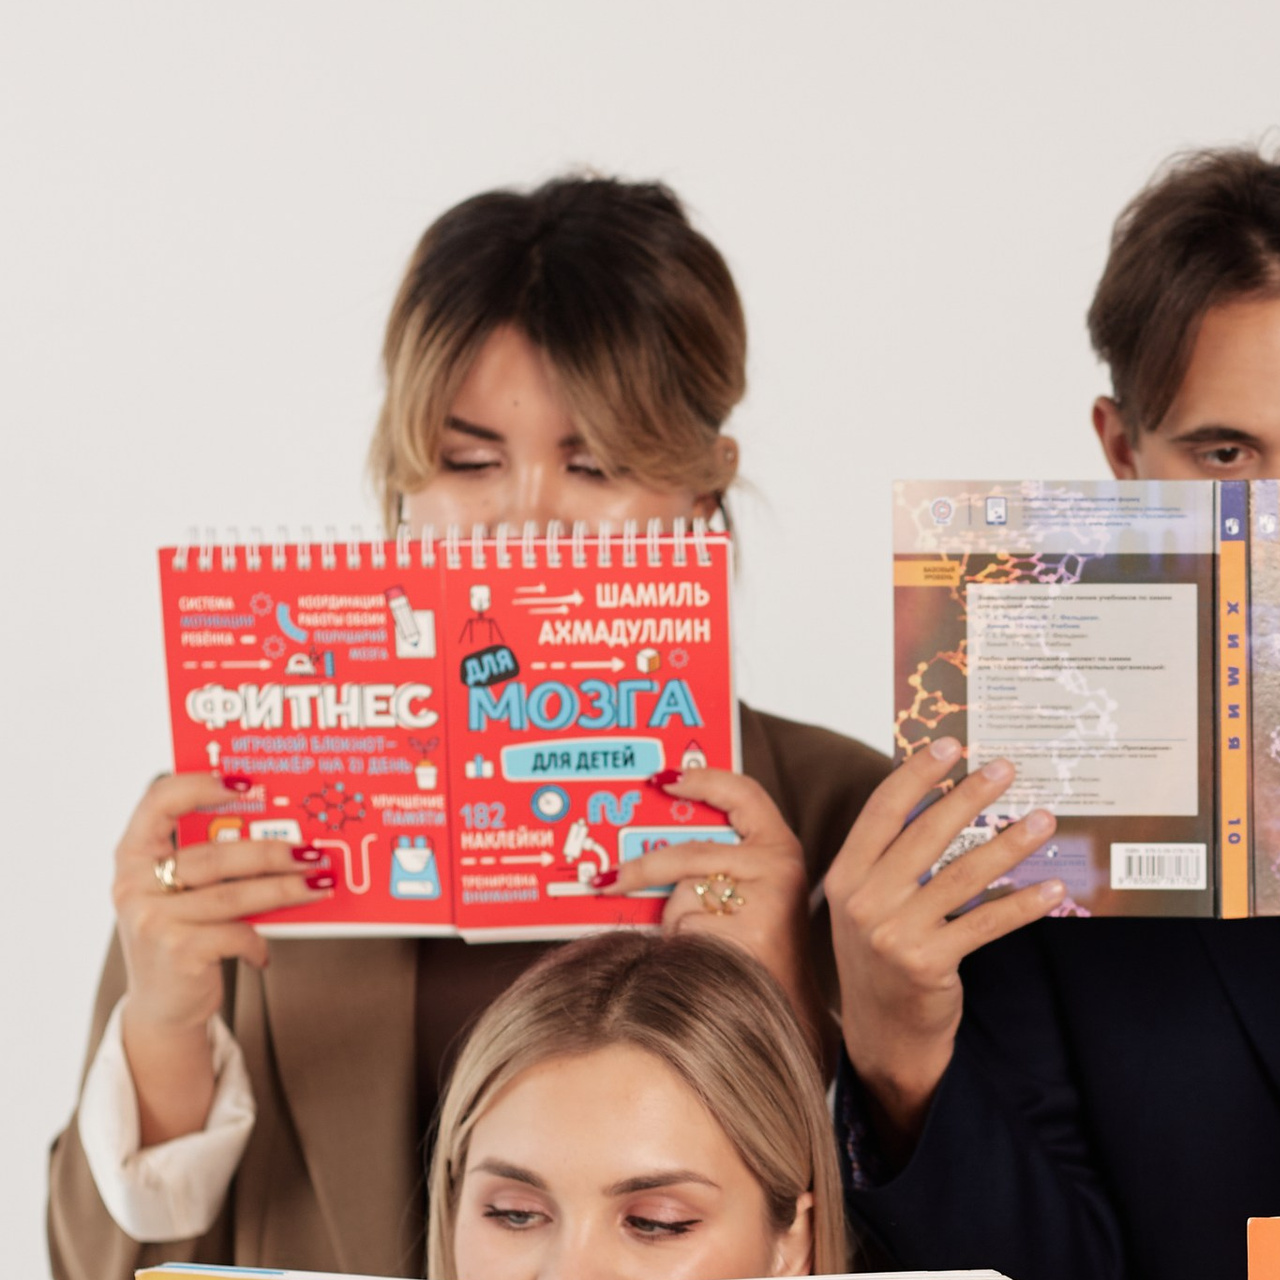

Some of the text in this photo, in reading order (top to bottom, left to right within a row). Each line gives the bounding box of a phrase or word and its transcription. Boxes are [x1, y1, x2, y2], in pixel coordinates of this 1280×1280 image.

[595, 582, 711, 609] ШАМИЛЬ
[538, 618, 711, 648] АХМАДУЛЛИН
[464, 648, 516, 687] ДЛЯ
[185, 682, 439, 731] ФИТНЕС
[467, 678, 704, 732] МОЗГА
[231, 733, 308, 753] ИГРОВОЙ
[367, 757, 413, 776] ДЕНЬ
[532, 745, 635, 773] ДЛЯ ДЕТЕЙ
[460, 801, 506, 830] 182
[461, 825, 554, 850] НАКЛЕЙКИ
